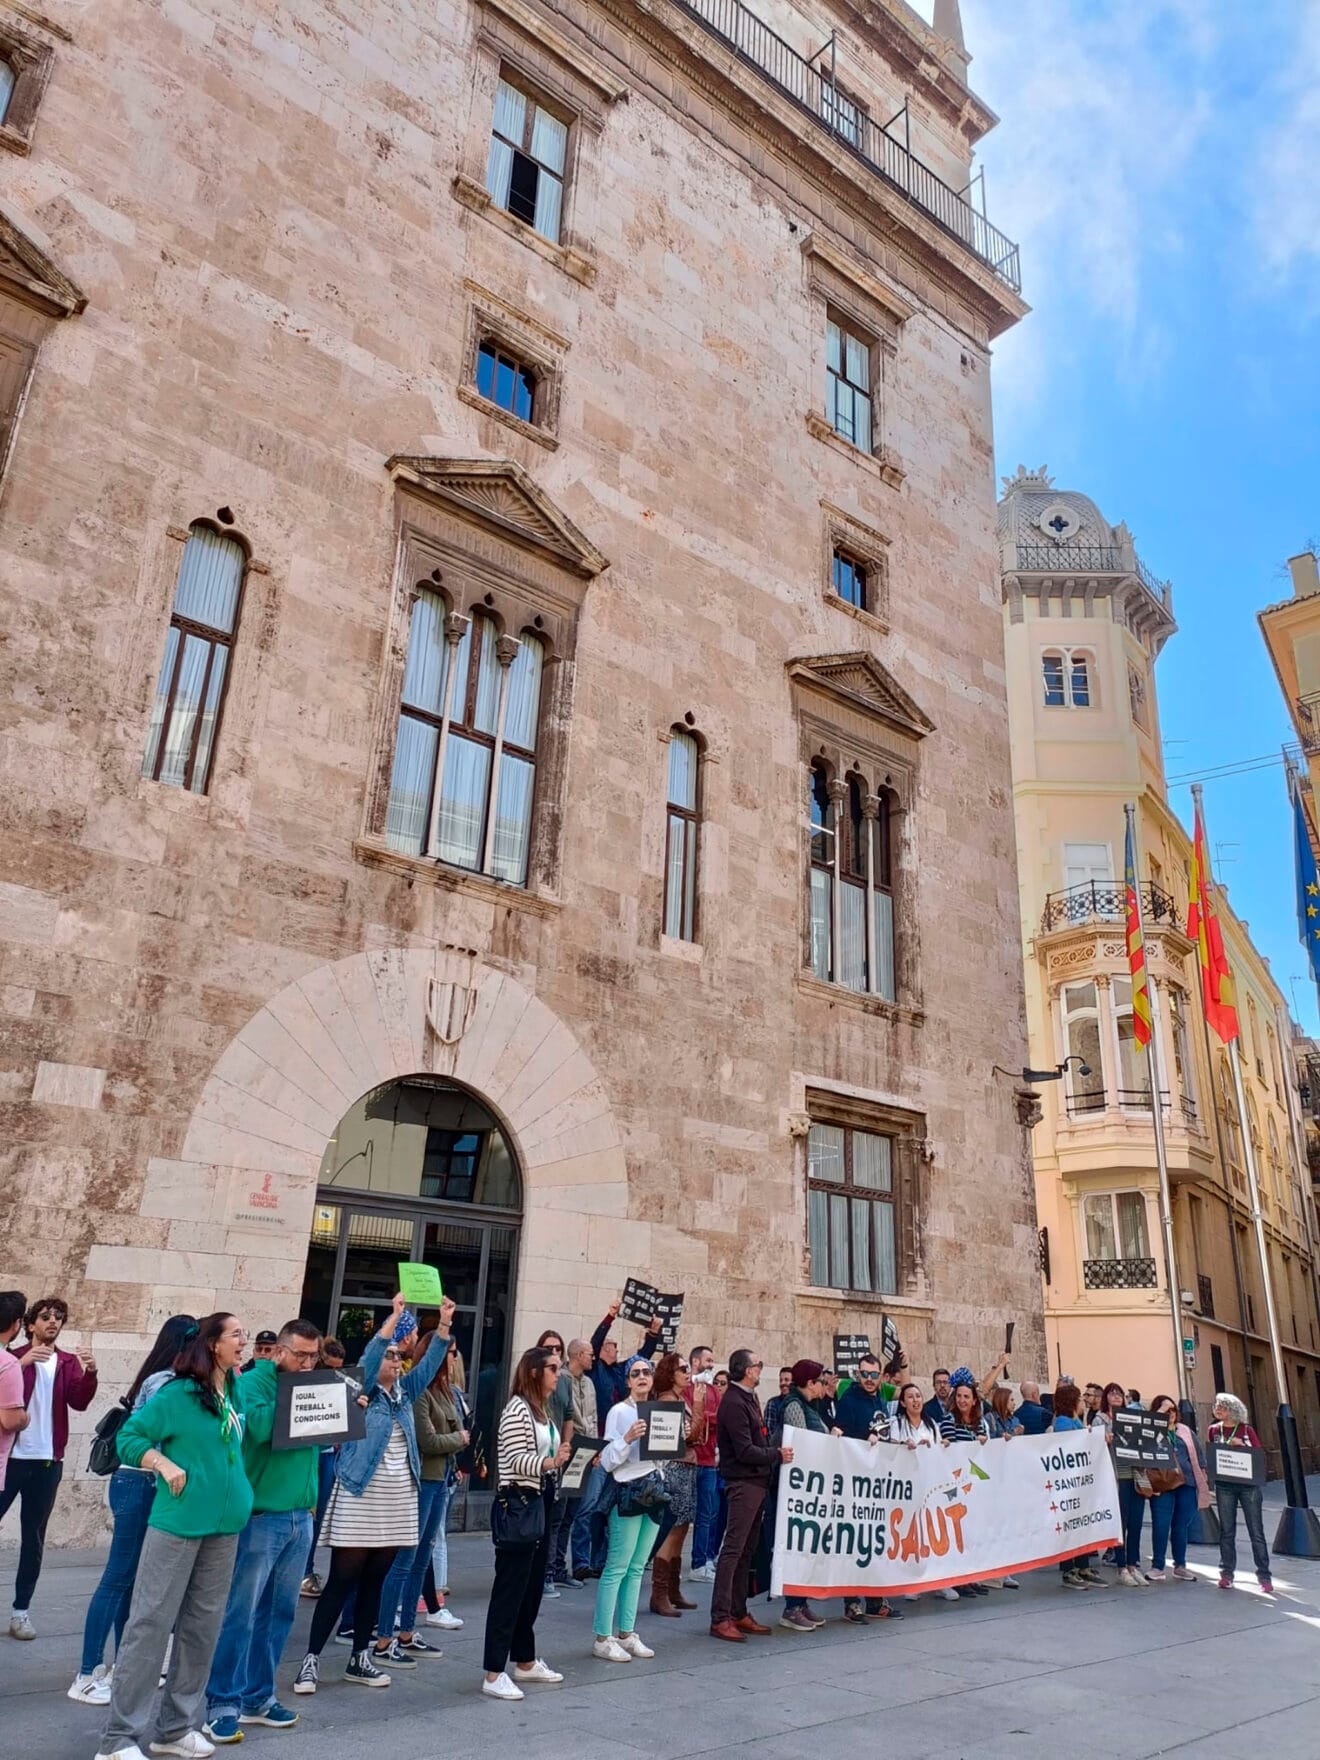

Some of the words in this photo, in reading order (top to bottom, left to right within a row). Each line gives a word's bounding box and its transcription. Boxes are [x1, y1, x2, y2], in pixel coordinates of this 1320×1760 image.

[295, 1392, 316, 1400] IGUAL
[295, 1403, 326, 1412] TREBALL
[294, 1413, 341, 1423] CONDICIONS
[1040, 1447, 1092, 1472] volem:
[789, 1466, 825, 1495] en
[787, 1496, 827, 1518] cada
[852, 1502, 886, 1521] tenim
[1059, 1498, 1081, 1512] CITES
[786, 1516, 886, 1568] menys
[887, 1502, 968, 1564] SALUT
